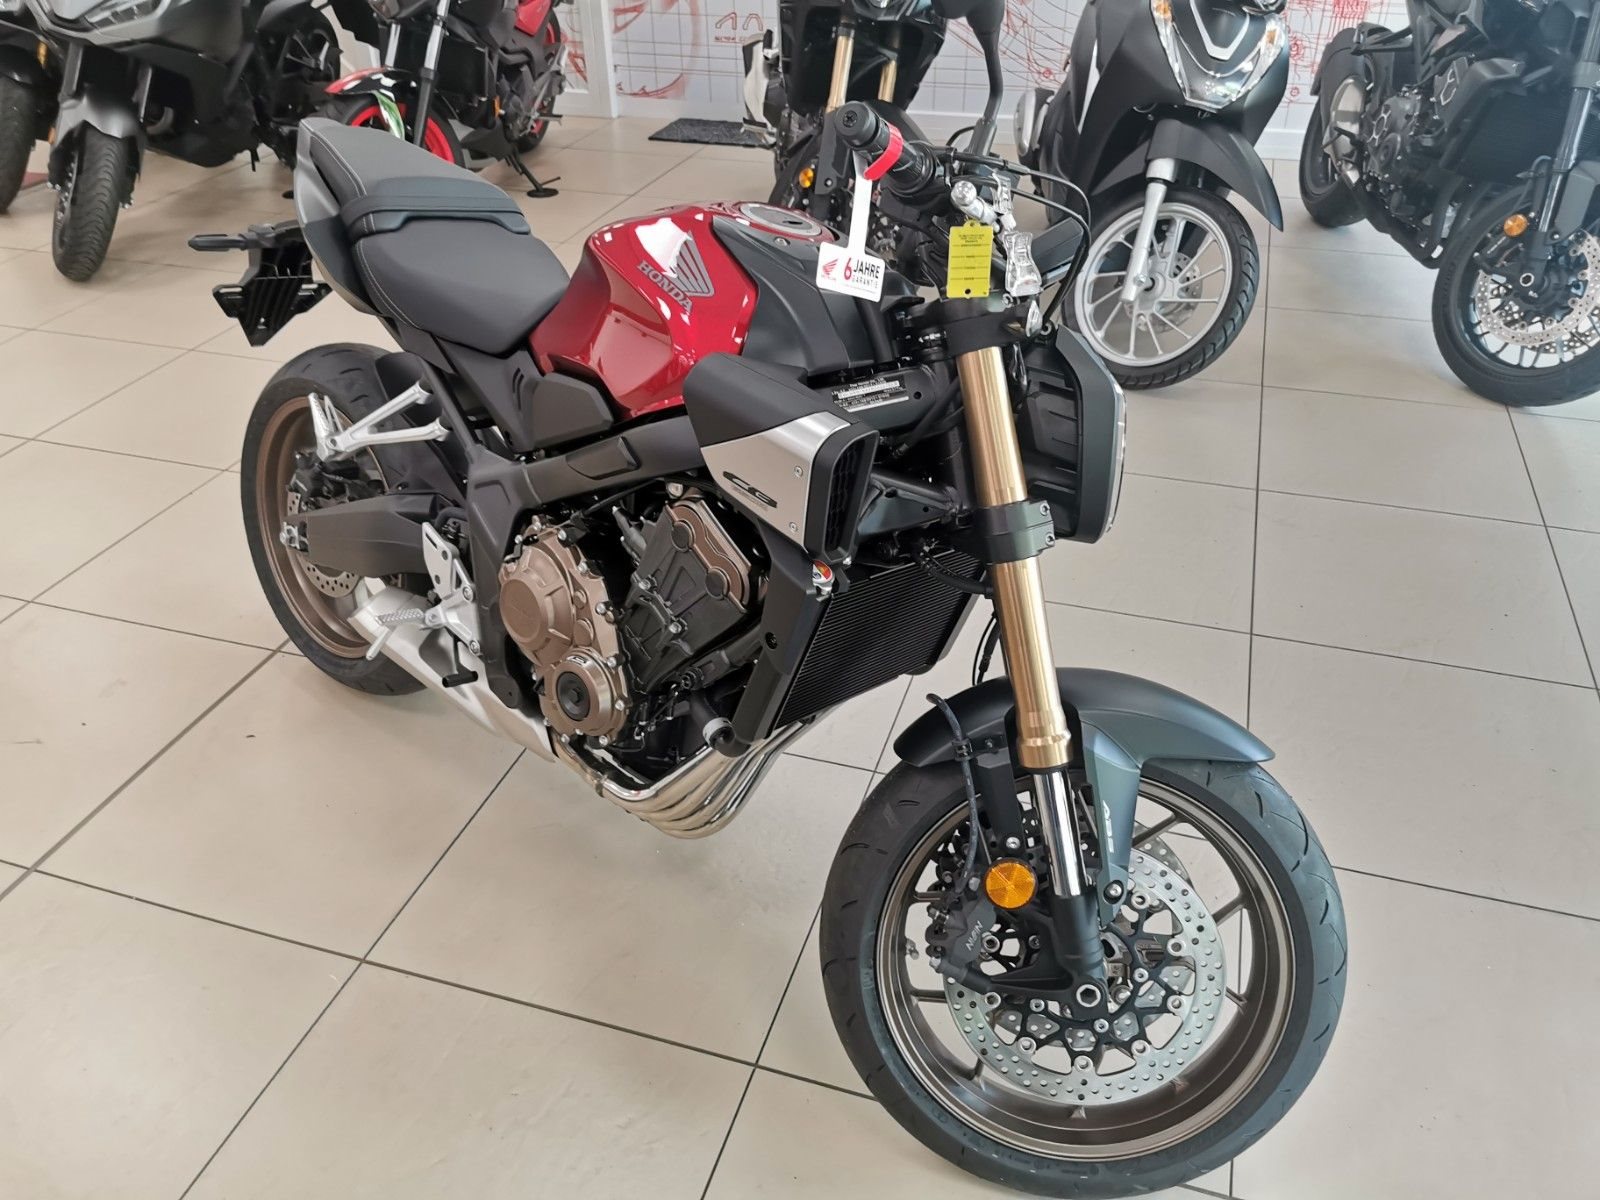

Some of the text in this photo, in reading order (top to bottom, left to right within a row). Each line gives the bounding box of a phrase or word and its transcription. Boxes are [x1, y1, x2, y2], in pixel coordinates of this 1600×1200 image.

[637, 260, 693, 314] HONDA
[844, 257, 880, 280] 6 JAHRE
